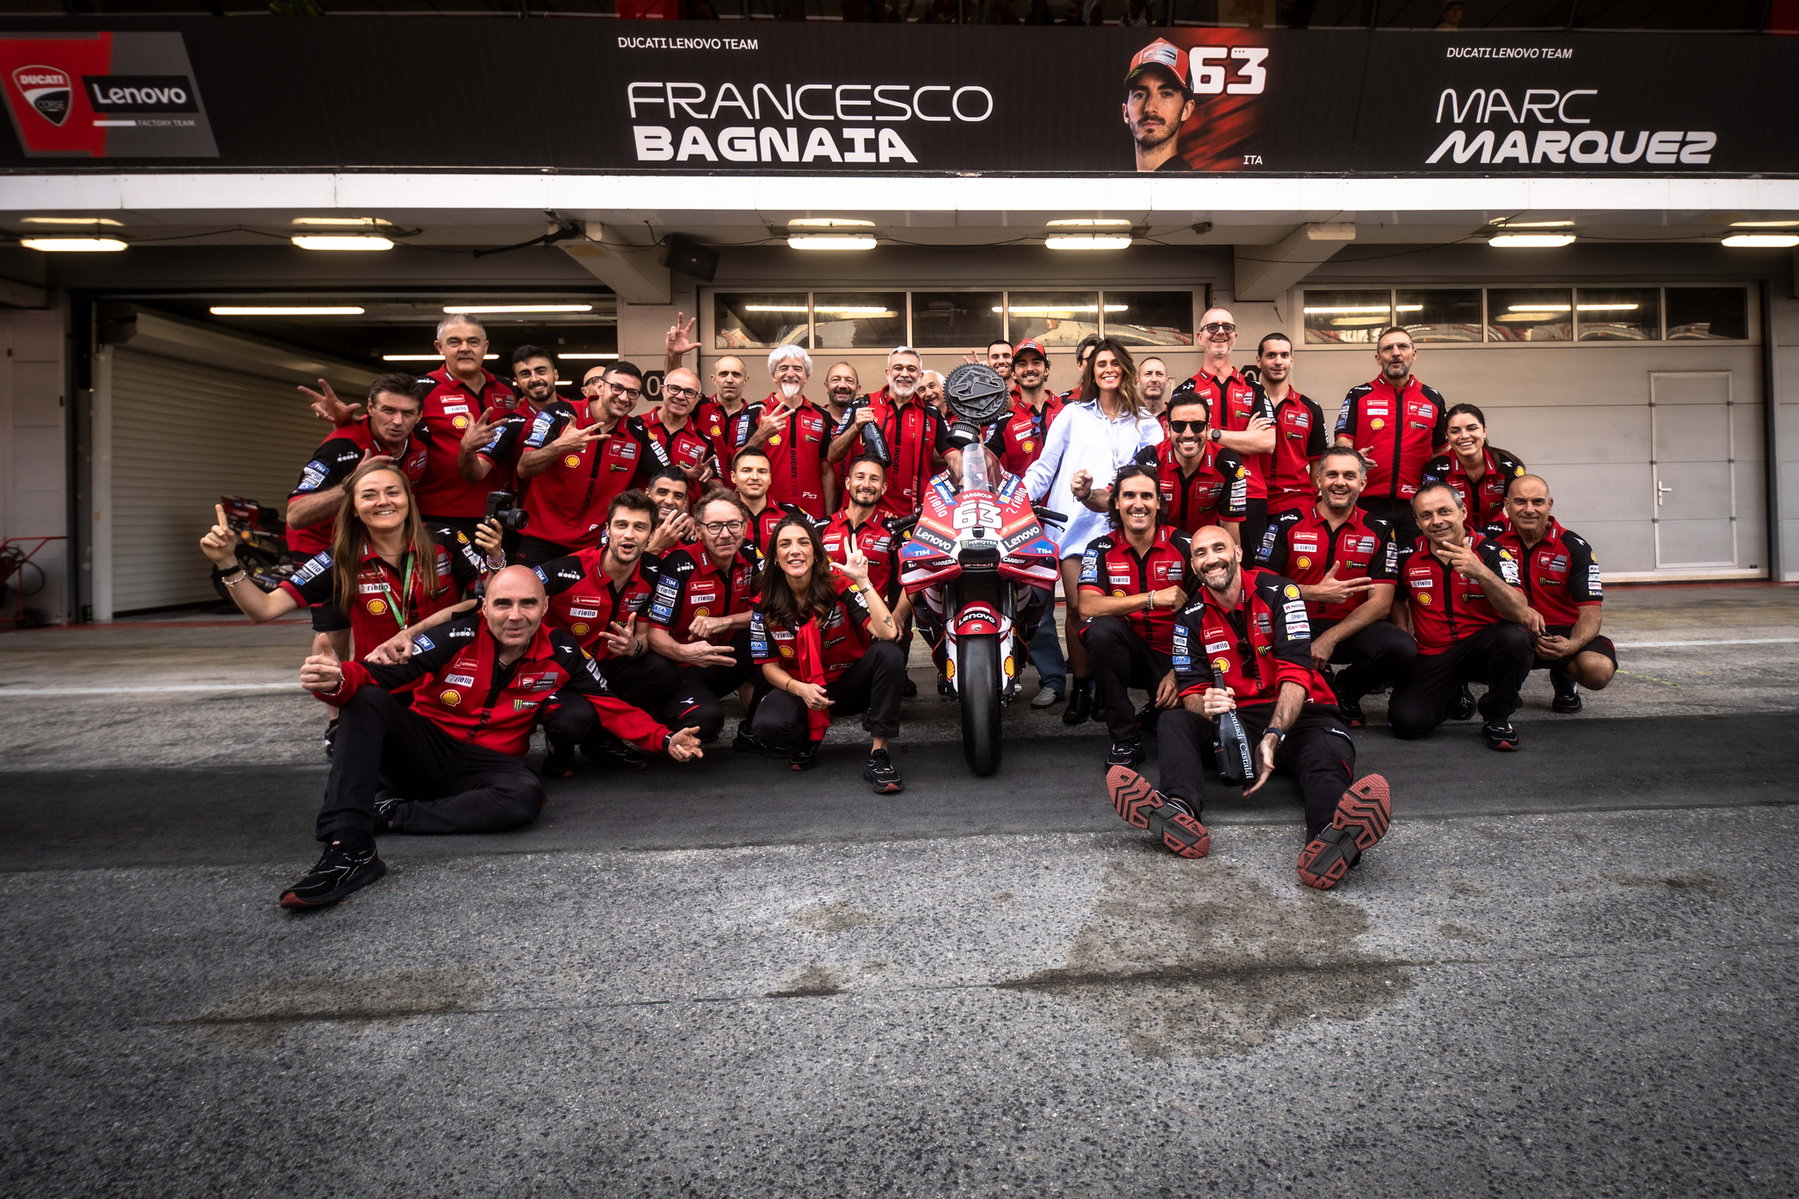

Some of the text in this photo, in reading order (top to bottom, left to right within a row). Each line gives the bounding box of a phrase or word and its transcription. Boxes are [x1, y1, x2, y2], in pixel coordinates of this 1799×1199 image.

[618, 37, 758, 50] DUCATI LENOVO TEAM
[1447, 48, 1573, 59] DUCATI LENOVO TEAM
[1190, 47, 1268, 94] 63
[20, 75, 64, 84] DUCATI
[93, 83, 187, 104] Lenovo
[628, 82, 994, 122] FRANCESCO
[1436, 88, 1598, 124] MARC
[633, 125, 919, 163] BAGNAIA
[1243, 154, 1263, 165] ITA
[314, 463, 326, 473] TIM
[1011, 487, 1028, 509] riello
[928, 494, 948, 518] riello
[953, 500, 1003, 530] 63
[916, 527, 952, 550] Lenovo
[1004, 526, 1040, 549] Lenovo
[318, 554, 330, 565] TIM
[535, 570, 545, 581] TIM
[665, 578, 676, 587] TIM
[958, 612, 995, 626] Lenovo
[418, 637, 430, 647] TIM
[1212, 642, 1229, 651] riello
[454, 676, 472, 685] riello
